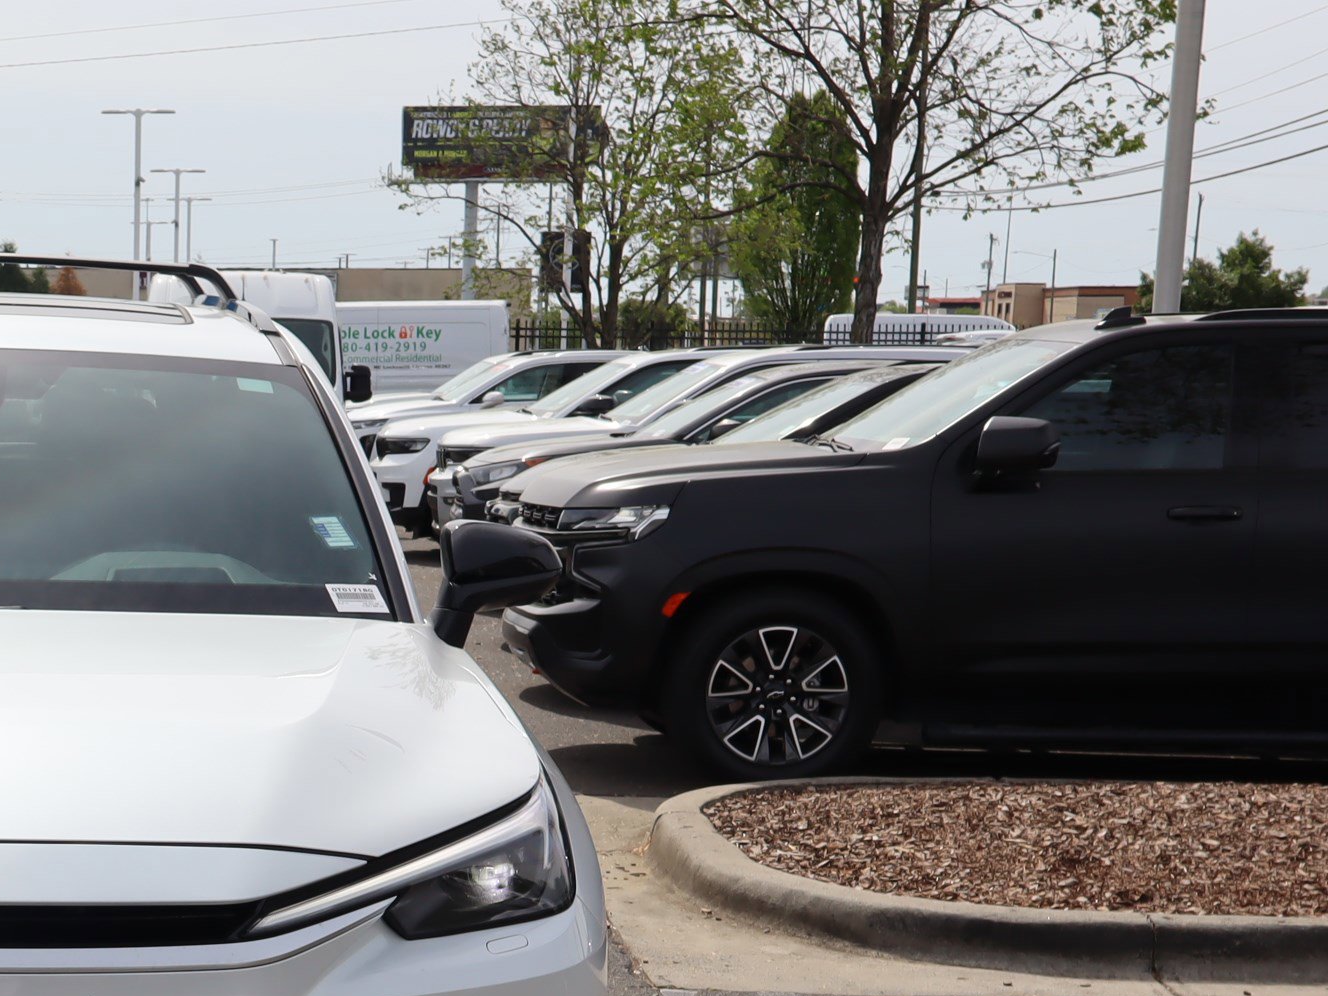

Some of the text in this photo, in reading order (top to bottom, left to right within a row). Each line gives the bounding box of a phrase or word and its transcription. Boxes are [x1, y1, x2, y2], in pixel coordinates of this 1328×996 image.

[364, 326, 395, 339] Lock
[416, 326, 441, 342] Key
[395, 353, 442, 362] Residential
